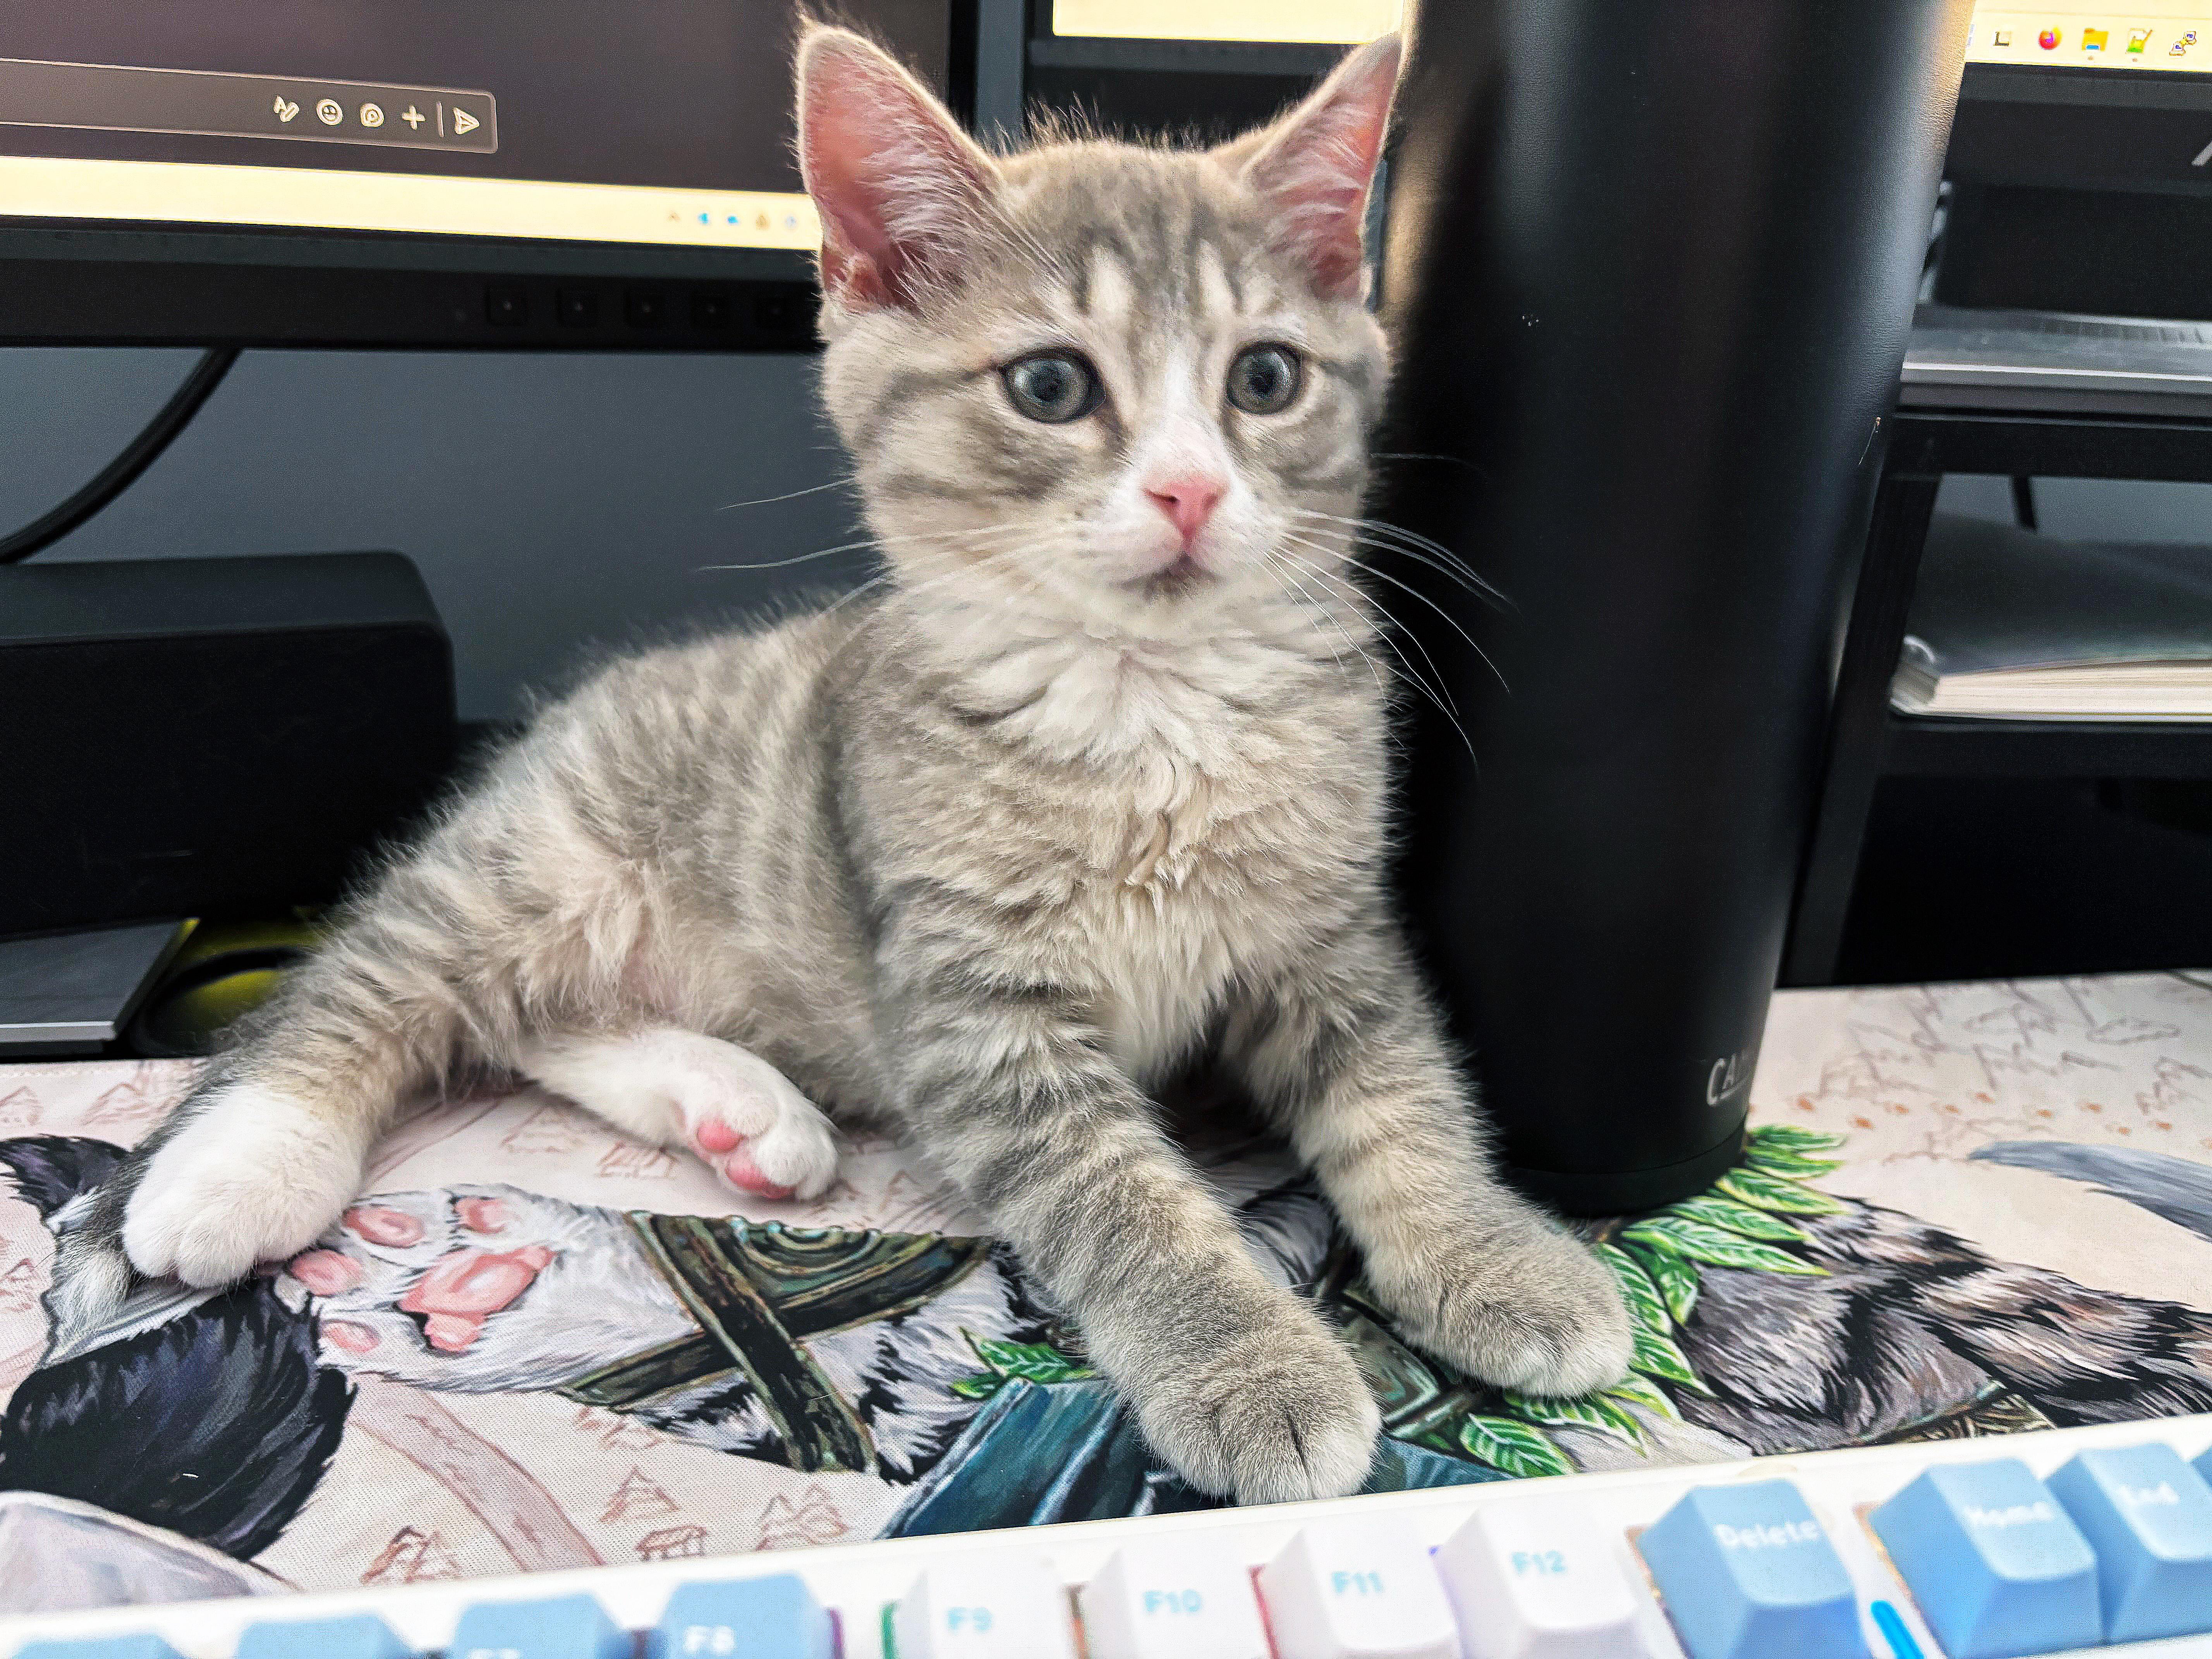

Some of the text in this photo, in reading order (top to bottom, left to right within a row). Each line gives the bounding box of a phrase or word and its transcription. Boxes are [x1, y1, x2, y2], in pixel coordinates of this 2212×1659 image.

[1707, 1052, 1745, 1106] CA
[1713, 1519, 1819, 1548] Delete
[1511, 1550, 1568, 1576] F12
[1331, 1570, 1384, 1595] F11
[1143, 1589, 1202, 1614] F10
[946, 1606, 994, 1634] F9
